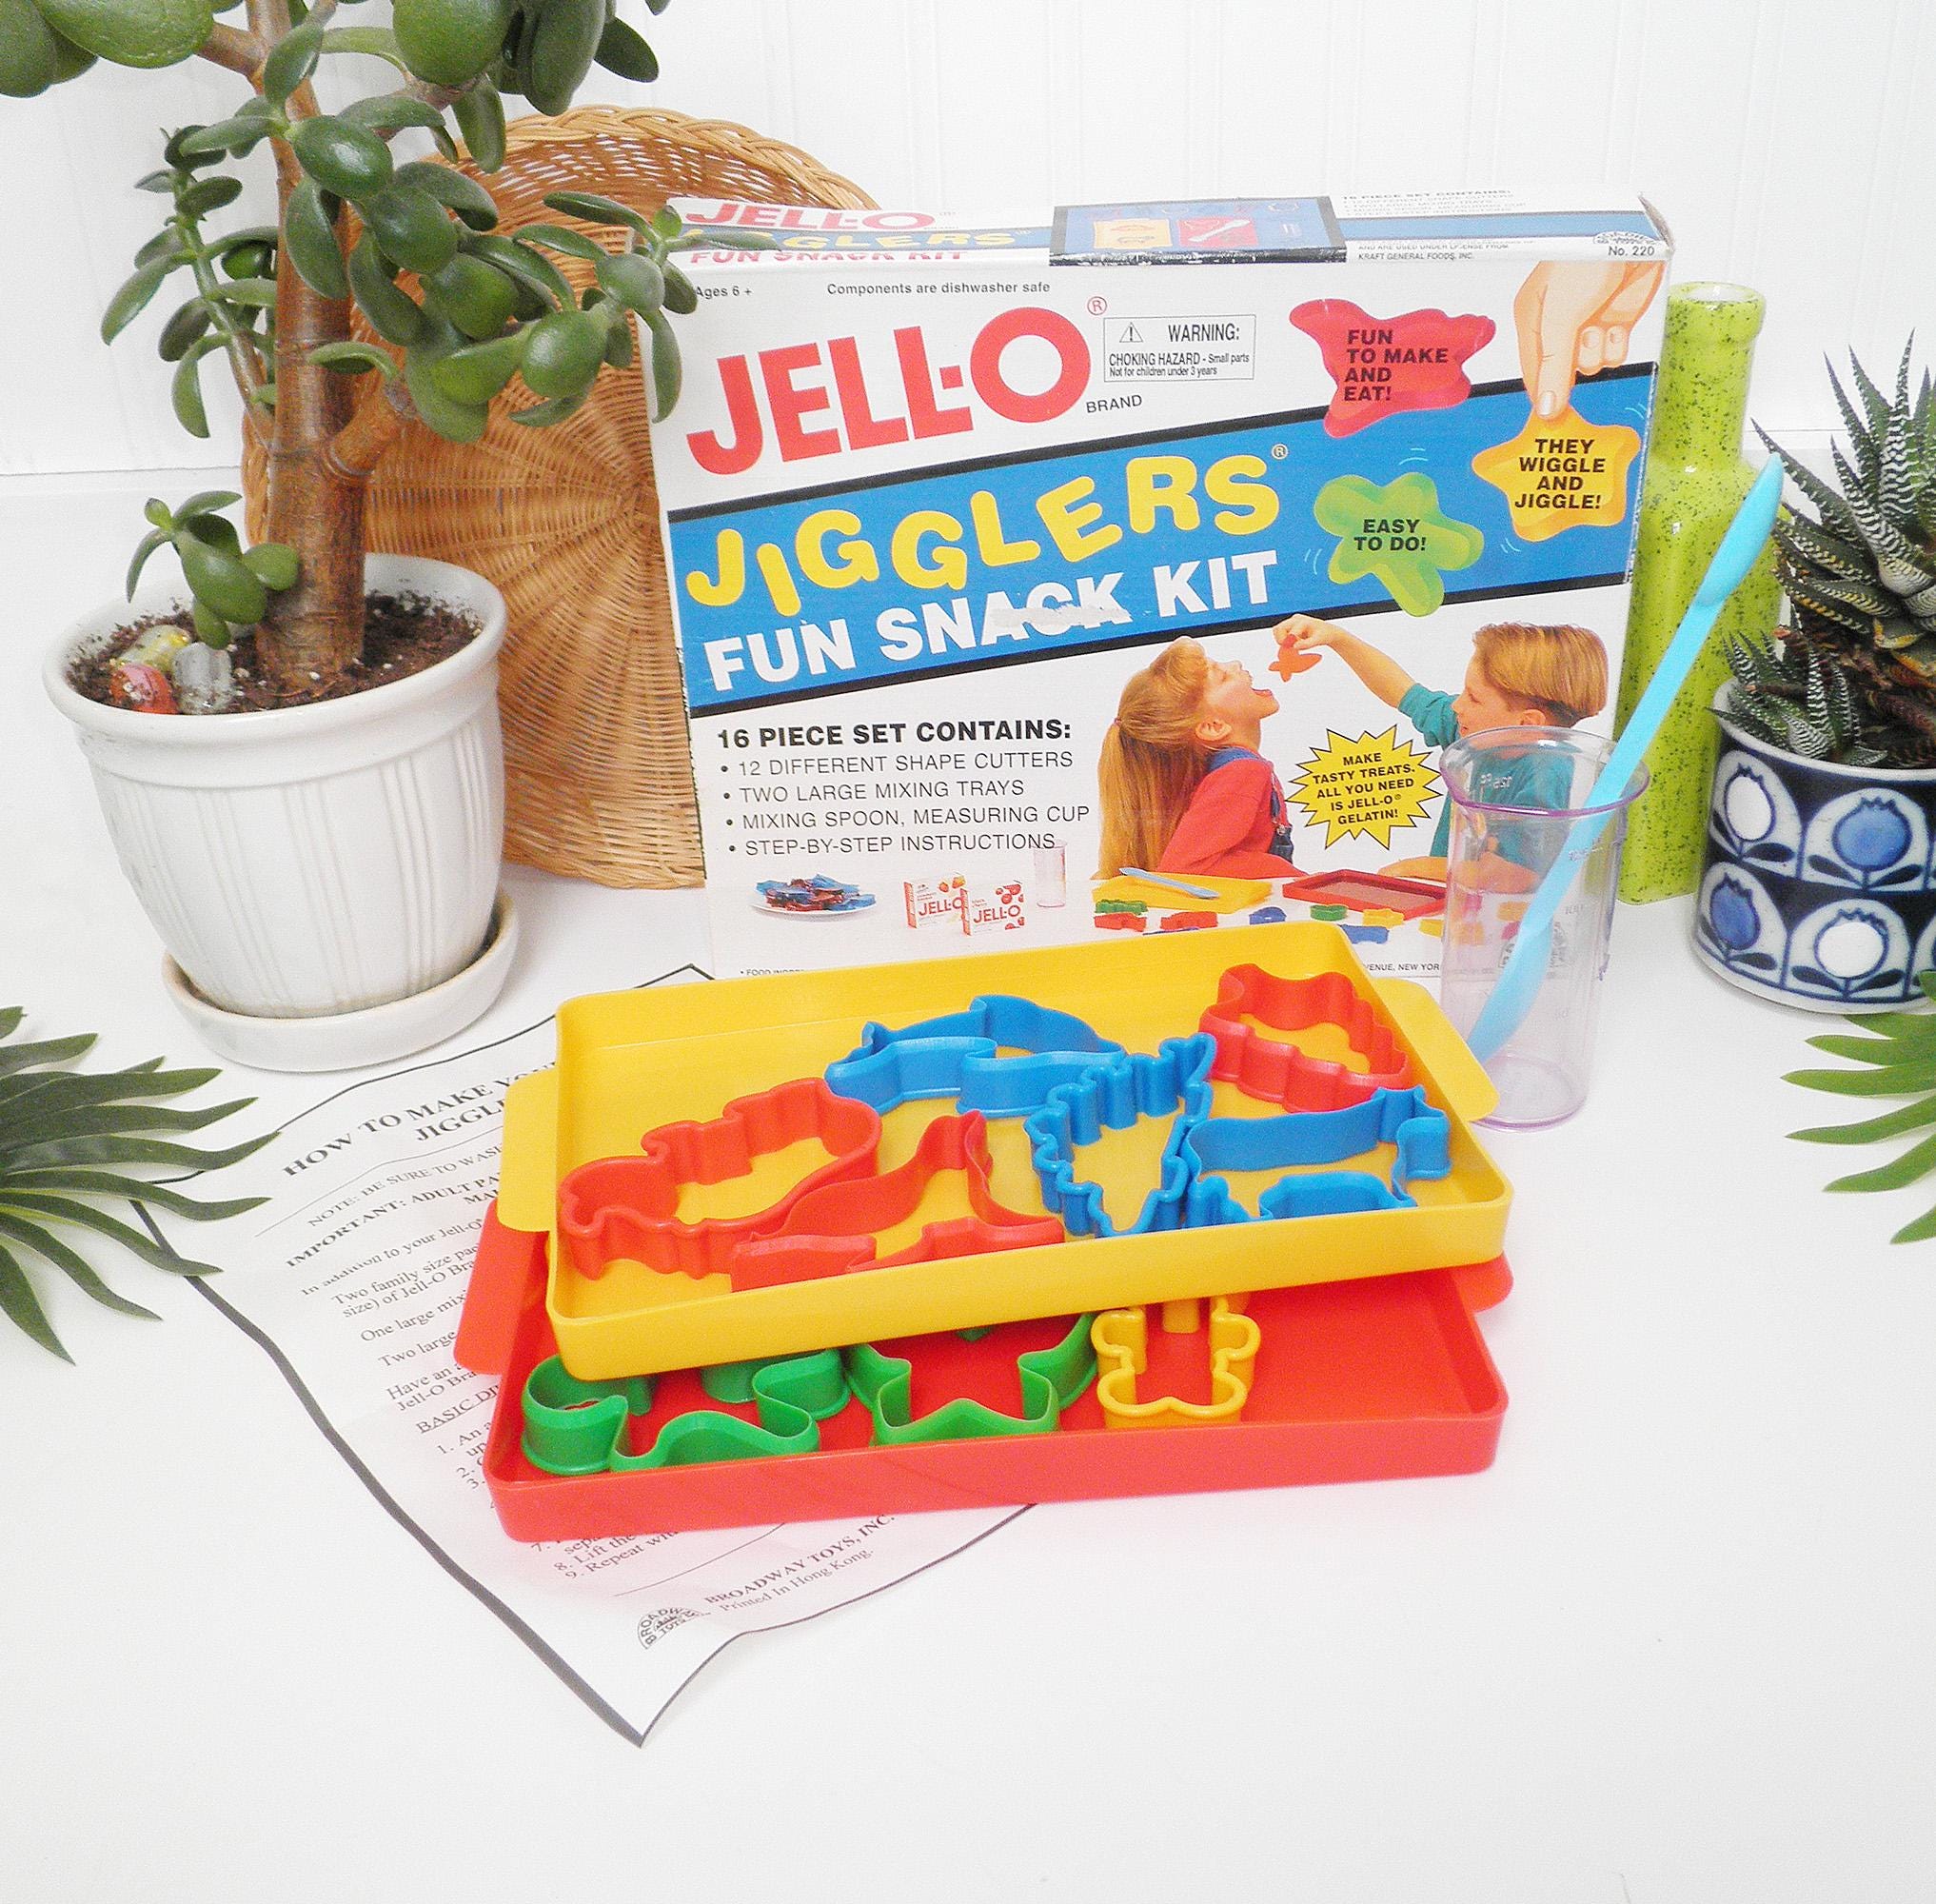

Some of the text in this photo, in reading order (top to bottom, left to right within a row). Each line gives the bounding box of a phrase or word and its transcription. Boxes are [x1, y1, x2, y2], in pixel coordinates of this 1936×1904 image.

[683, 229, 1016, 248] GLERS
[690, 251, 761, 264] FUN
[1608, 246, 1655, 256] No. 220
[696, 286, 728, 300] Ages
[732, 286, 741, 297] 6
[826, 281, 1051, 297] Components are dishwasher safe
[1168, 323, 1240, 343] WARNING:
[1347, 329, 1393, 345] FUN
[1109, 352, 1156, 367] CHOKING
[1157, 352, 1201, 366] HAZARD
[1208, 352, 1230, 364] Small
[1230, 353, 1250, 367] parts
[1347, 347, 1449, 364] TO MAKE
[1109, 366, 1217, 378] Not for children under 3 years
[1344, 367, 1393, 383] AND
[686, 307, 1091, 475] JELL-O
[1343, 386, 1392, 402] EAT!
[1086, 394, 1143, 414] BRAND
[1534, 438, 1595, 454] THEY
[1518, 457, 1607, 473] WIGGLE
[1536, 476, 1584, 491] AND
[1514, 493, 1602, 509] JIGGLE!
[686, 454, 1280, 617] JIGGLERS
[1362, 519, 1421, 534] EASY
[1353, 536, 1427, 552] TO DO!
[703, 549, 1278, 692] FUN SNACK KIT
[718, 719, 1072, 749] 16 PIECE SET CONTAINS:
[739, 750, 1074, 777] 12 DIFFERENT SHAPE CUTTERS
[1342, 752, 1382, 766] MAKE
[1313, 764, 1415, 784] TASTY TREATS.
[739, 779, 1025, 803] TWO LARGE MIXING TRAYS
[1316, 778, 1414, 800] ALL YOU NEED
[1331, 801, 1343, 811] IS
[742, 805, 1090, 829] MIXING SPOON, MEASURING CUP
[1337, 808, 1399, 825] GELATIN!
[745, 833, 1057, 856] STEP-BY-STEP INSTRUCTIONS
[1364, 962, 1395, 972] VENUE,
[1420, 962, 1440, 971] YOR
[282, 1083, 493, 1177] HOW TO MAKE
[415, 1099, 504, 1142] JIGGL
[307, 1196, 360, 1227] NOTE:
[361, 1181, 385, 1198] BE
[386, 1168, 431, 1186] SURE
[432, 1162, 457, 1174] TO
[285, 1200, 406, 1267] IMPORTANT:
[411, 1182, 471, 1204] ADULT
[322, 1253, 383, 1287] addition
[384, 1248, 400, 1259] to
[403, 1234, 437, 1255] your
[330, 1243, 480, 1305] Two family size pac
[343, 1260, 475, 1319] size) of Jell-O Bra
[361, 1324, 394, 1341] One
[395, 1310, 435, 1330] large
[378, 1331, 457, 1368] Two large
[385, 1367, 453, 1400] Have an
[397, 1371, 477, 1411] Jell-O Bra
[416, 1398, 474, 1434] BASIC
[458, 1429, 483, 1446] An
[456, 1467, 475, 1478] 2.
[574, 1545, 608, 1564] Lift
[609, 1535, 636, 1549] the
[585, 1544, 645, 1573] Repeat
[703, 1515, 895, 1604] BROADWAY TOYS, INC.
[719, 1548, 874, 1612] Printed In Hong Kong.
